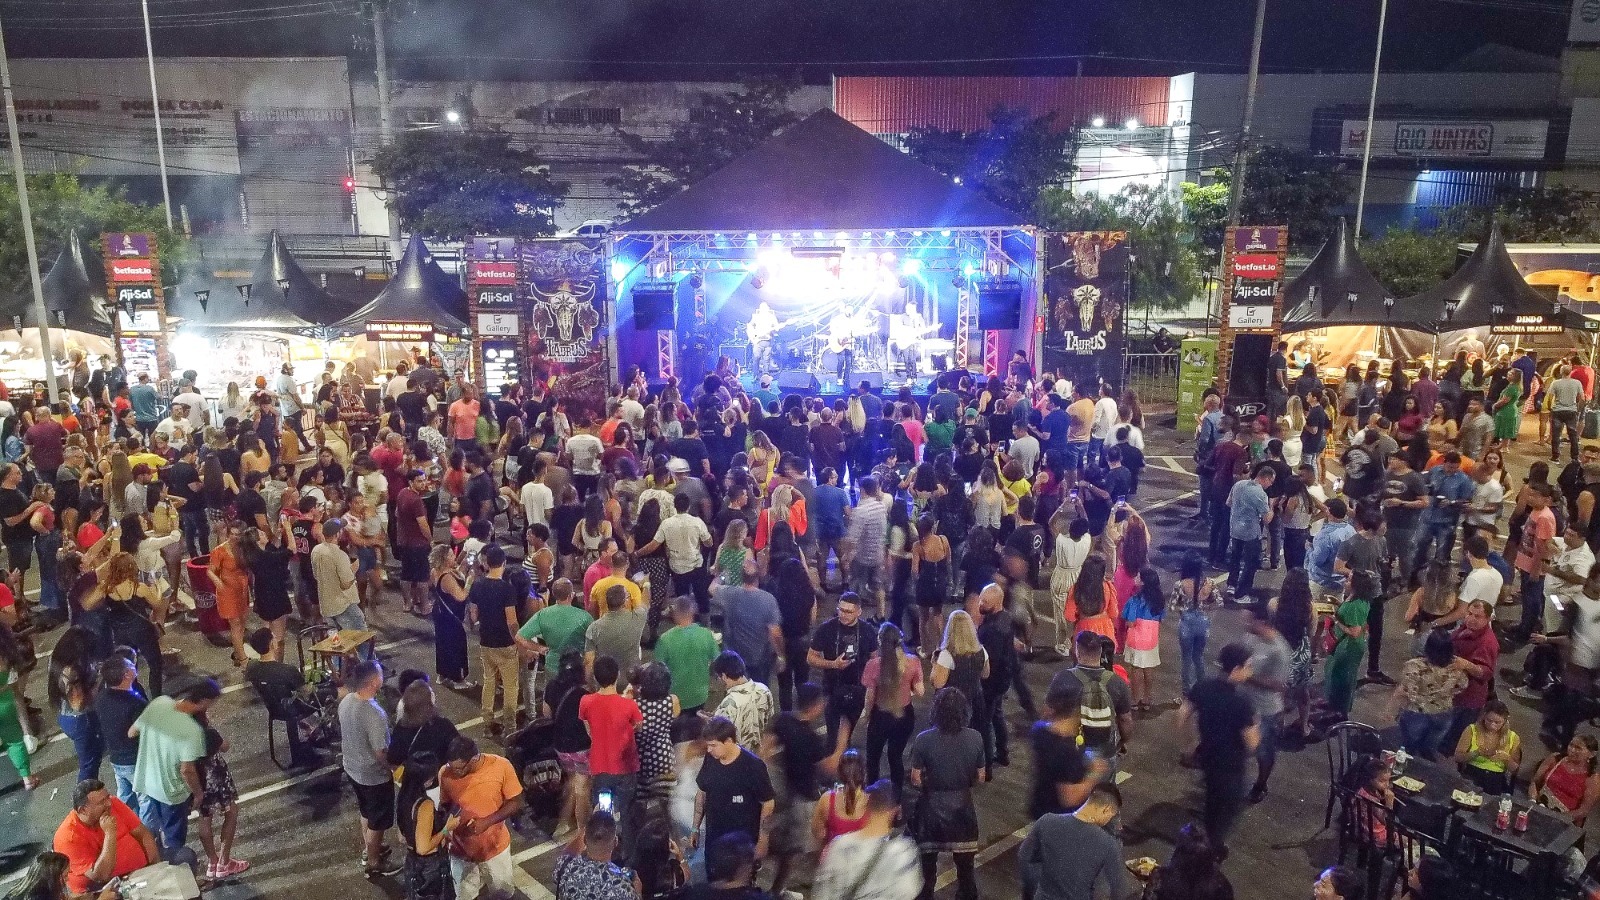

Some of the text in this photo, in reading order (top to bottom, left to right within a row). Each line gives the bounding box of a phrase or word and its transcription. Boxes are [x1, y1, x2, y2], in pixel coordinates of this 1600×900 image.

[1400, 129, 1426, 150] RIO
[1429, 129, 1488, 150] JUNTAS
[114, 266, 151, 274] betfast.io
[1235, 262, 1276, 271] betfast.io
[476, 269, 515, 278] betfast.io
[1236, 286, 1271, 299] Aji-Sal
[479, 292, 513, 303] Aji-Sal
[1237, 317, 1264, 325] Gallery
[1516, 315, 1543, 323] DINDO
[486, 324, 511, 333] Gallery
[1064, 330, 1107, 351] TAURUS
